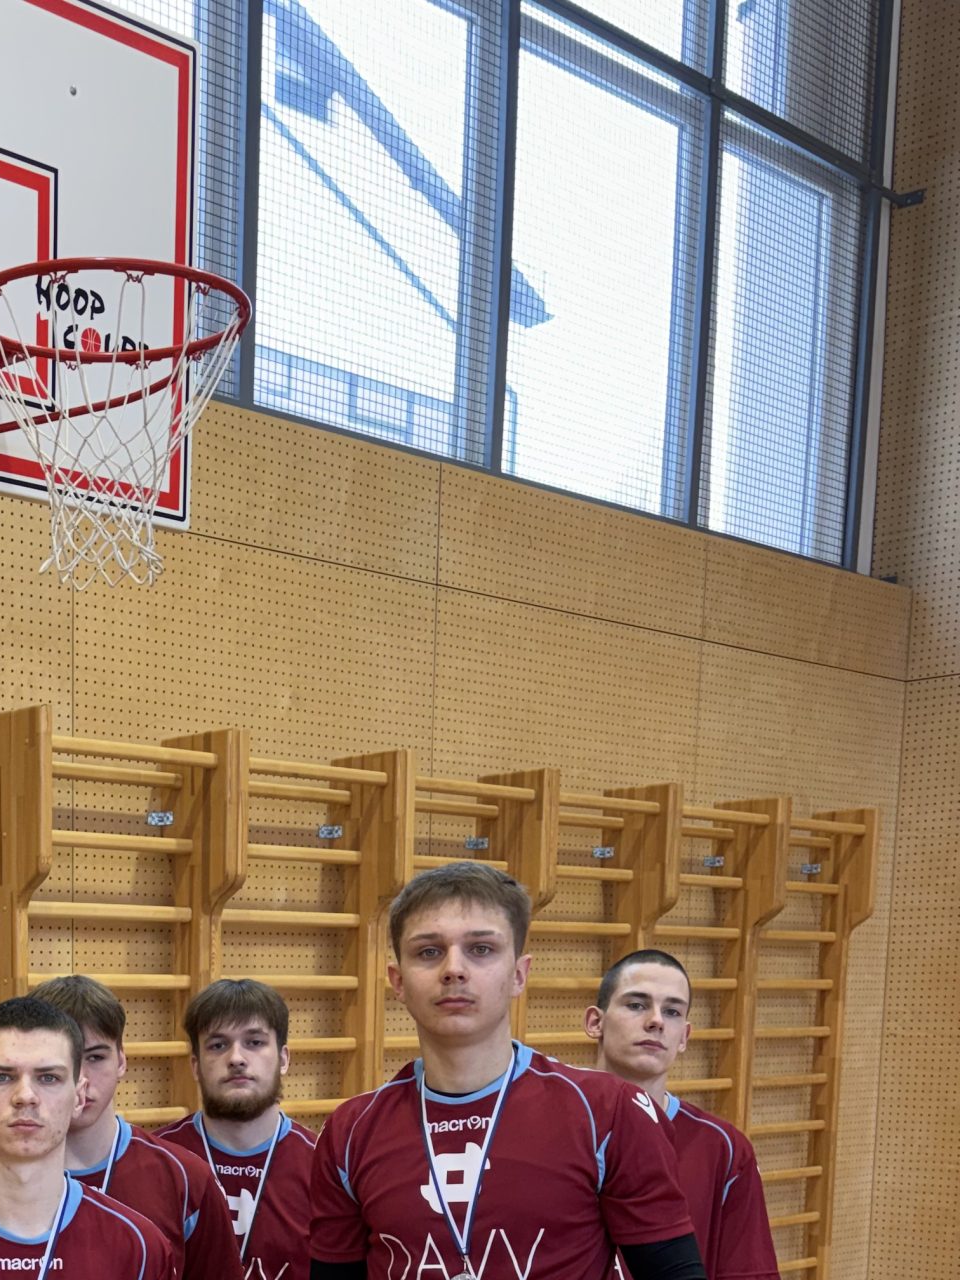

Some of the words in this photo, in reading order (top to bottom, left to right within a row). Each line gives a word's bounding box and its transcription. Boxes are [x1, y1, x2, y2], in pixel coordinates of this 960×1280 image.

[36, 273, 105, 320] HOOP
[427, 1115, 493, 1133] macron
[215, 1164, 264, 1178] macron
